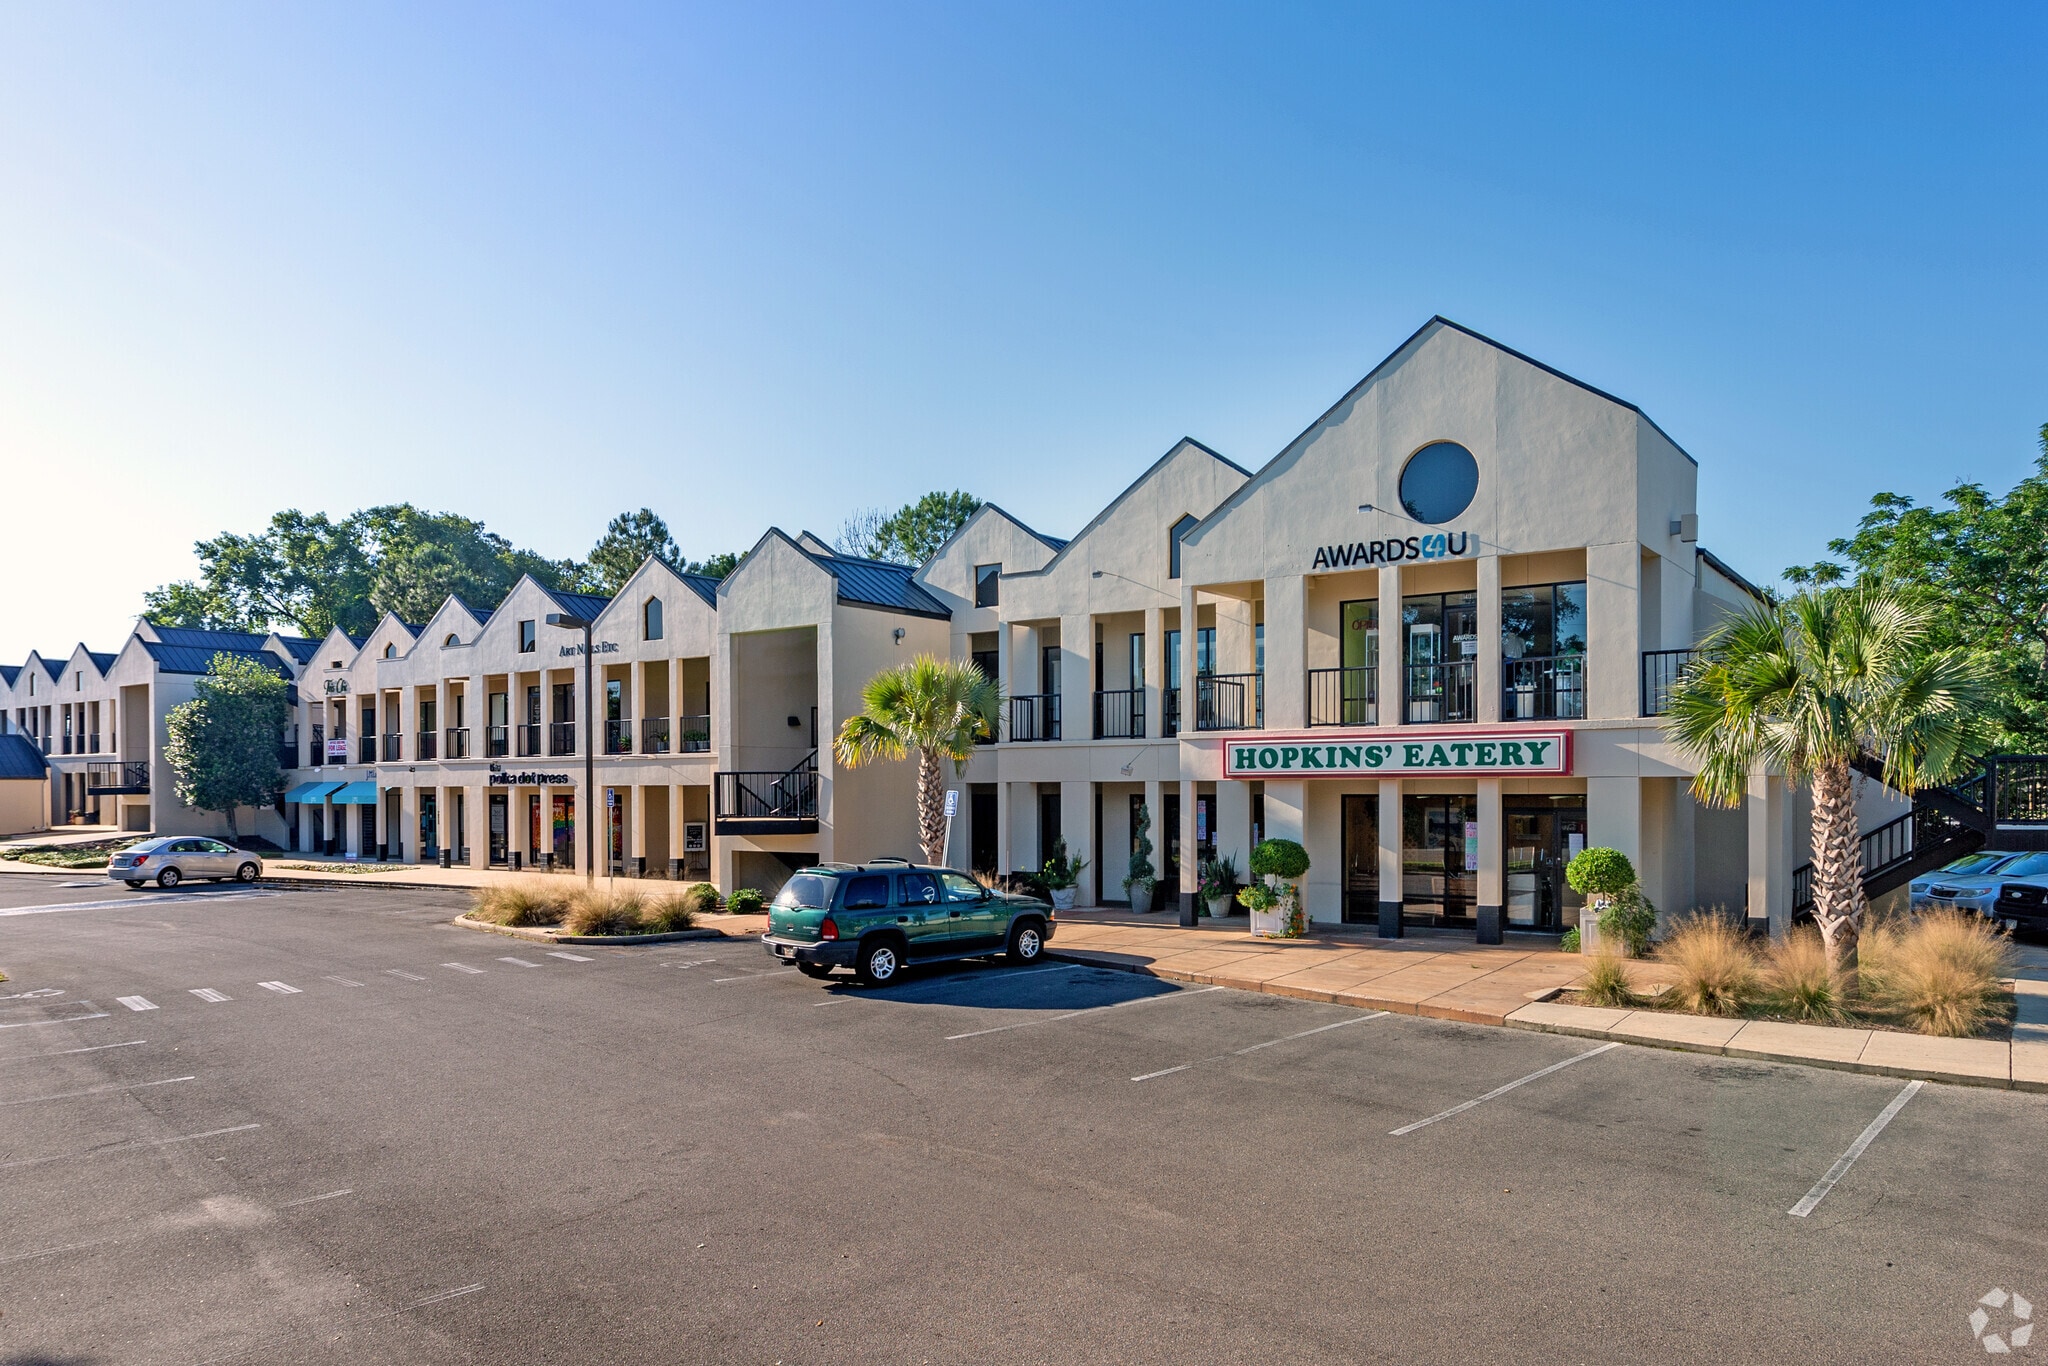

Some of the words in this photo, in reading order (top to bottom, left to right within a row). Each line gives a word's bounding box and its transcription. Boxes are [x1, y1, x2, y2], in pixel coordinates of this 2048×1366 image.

[1312, 531, 1467, 570] AWARDS4U
[576, 643, 601, 655] NLS
[1234, 745, 1393, 770] HOPKINS'
[1402, 740, 1551, 768] EATERY
[489, 772, 517, 787] polka
[517, 771, 537, 784] dot
[537, 773, 569, 786] press
